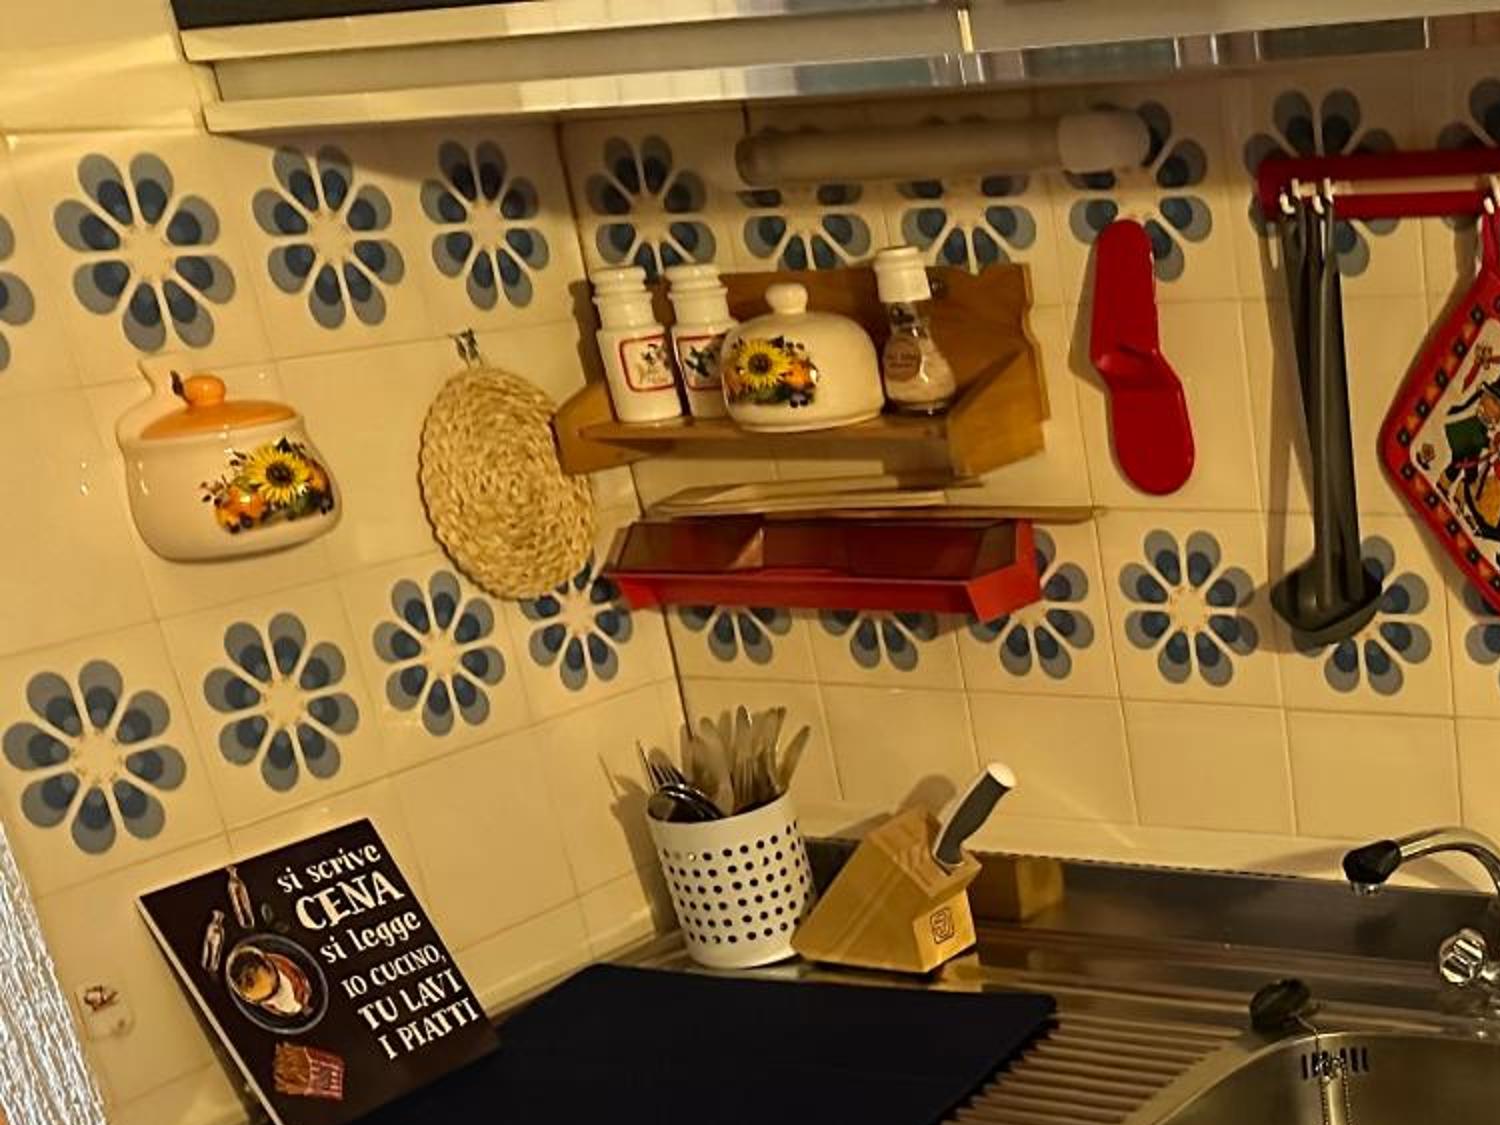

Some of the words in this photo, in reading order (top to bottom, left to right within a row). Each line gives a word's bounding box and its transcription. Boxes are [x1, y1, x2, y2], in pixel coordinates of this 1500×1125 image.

[277, 867, 302, 893] si
[307, 843, 381, 883] scrive
[295, 870, 405, 930] CENA
[320, 935, 347, 963] si
[347, 910, 421, 952] legge
[341, 974, 367, 999] IO
[358, 1000, 398, 1030] TU
[399, 968, 463, 1011] LAVI
[378, 1034, 398, 1060] I
[397, 997, 480, 1051] PIATTI
